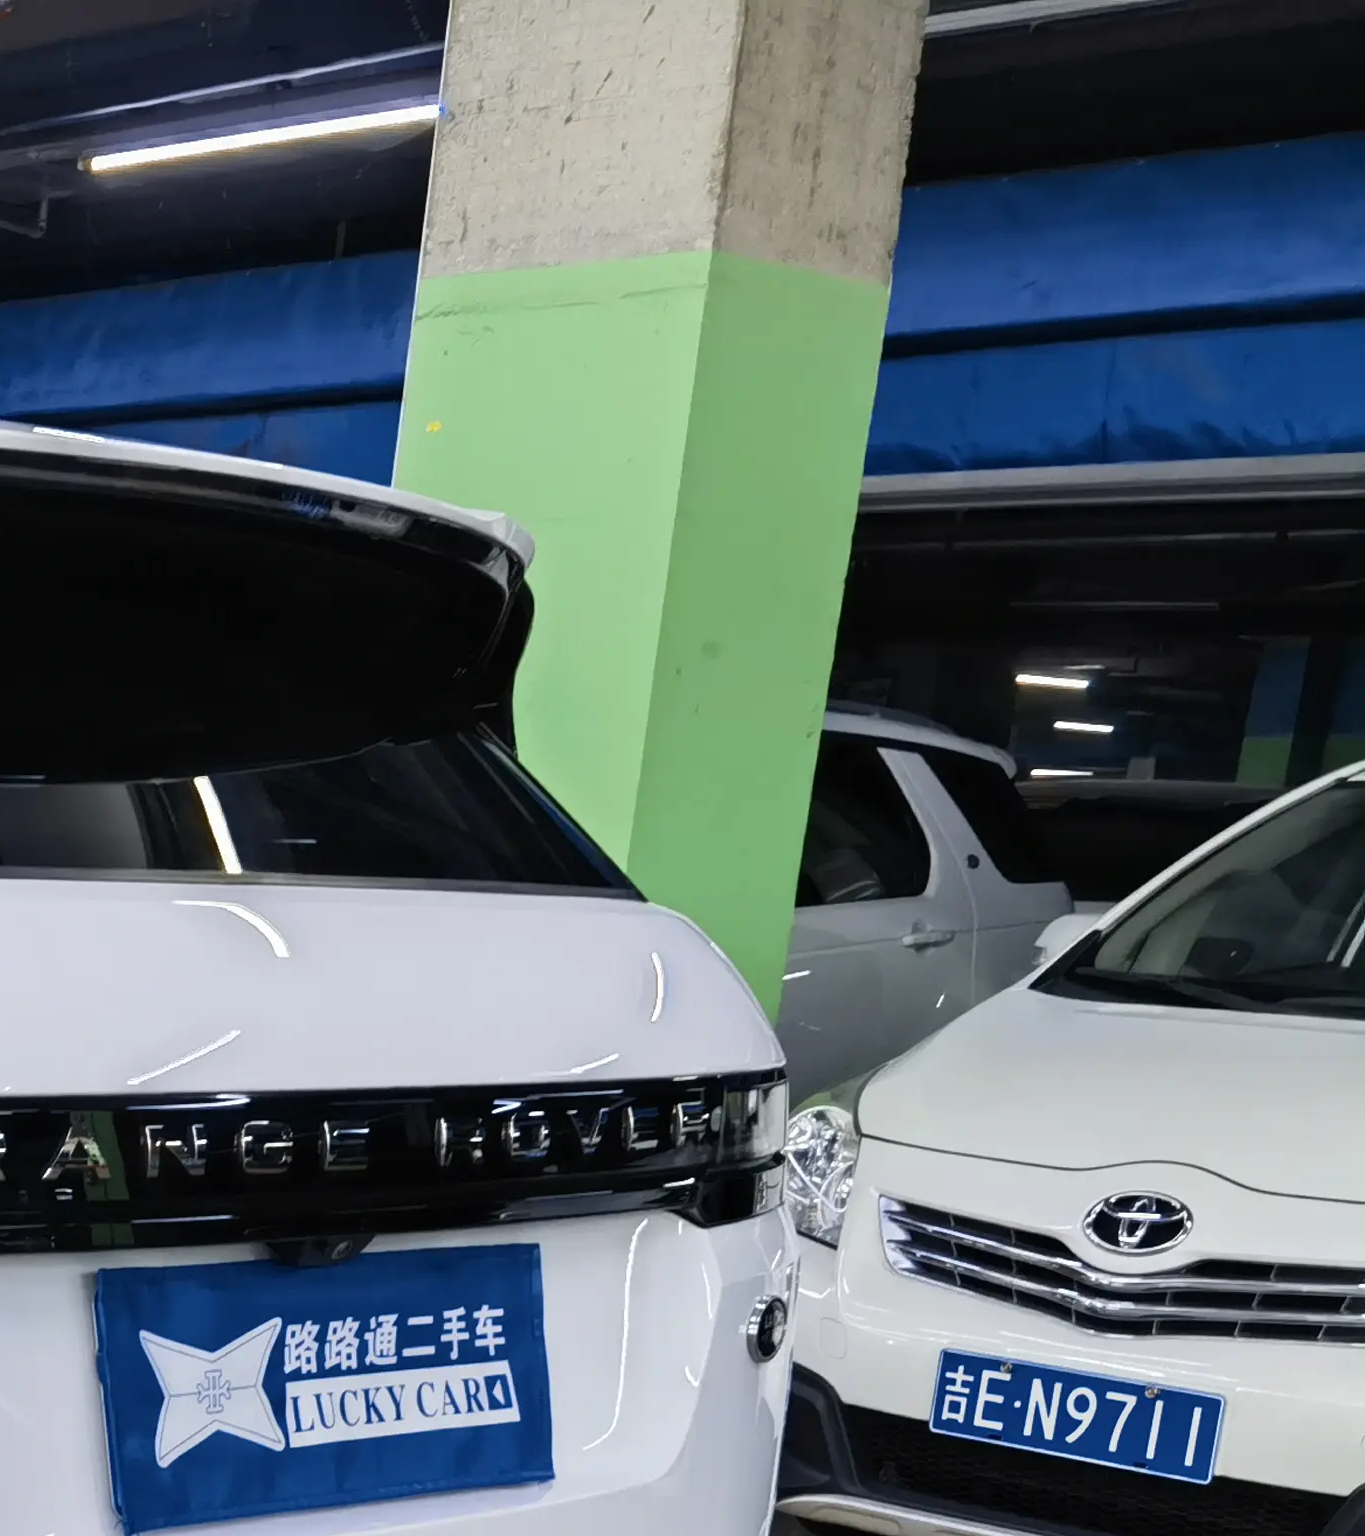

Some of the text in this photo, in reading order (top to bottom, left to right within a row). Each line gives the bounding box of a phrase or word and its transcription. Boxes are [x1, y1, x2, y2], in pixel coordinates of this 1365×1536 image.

[283, 1304, 506, 1375] 路路通二手车
[290, 1377, 486, 1433] LUCKY CAR
